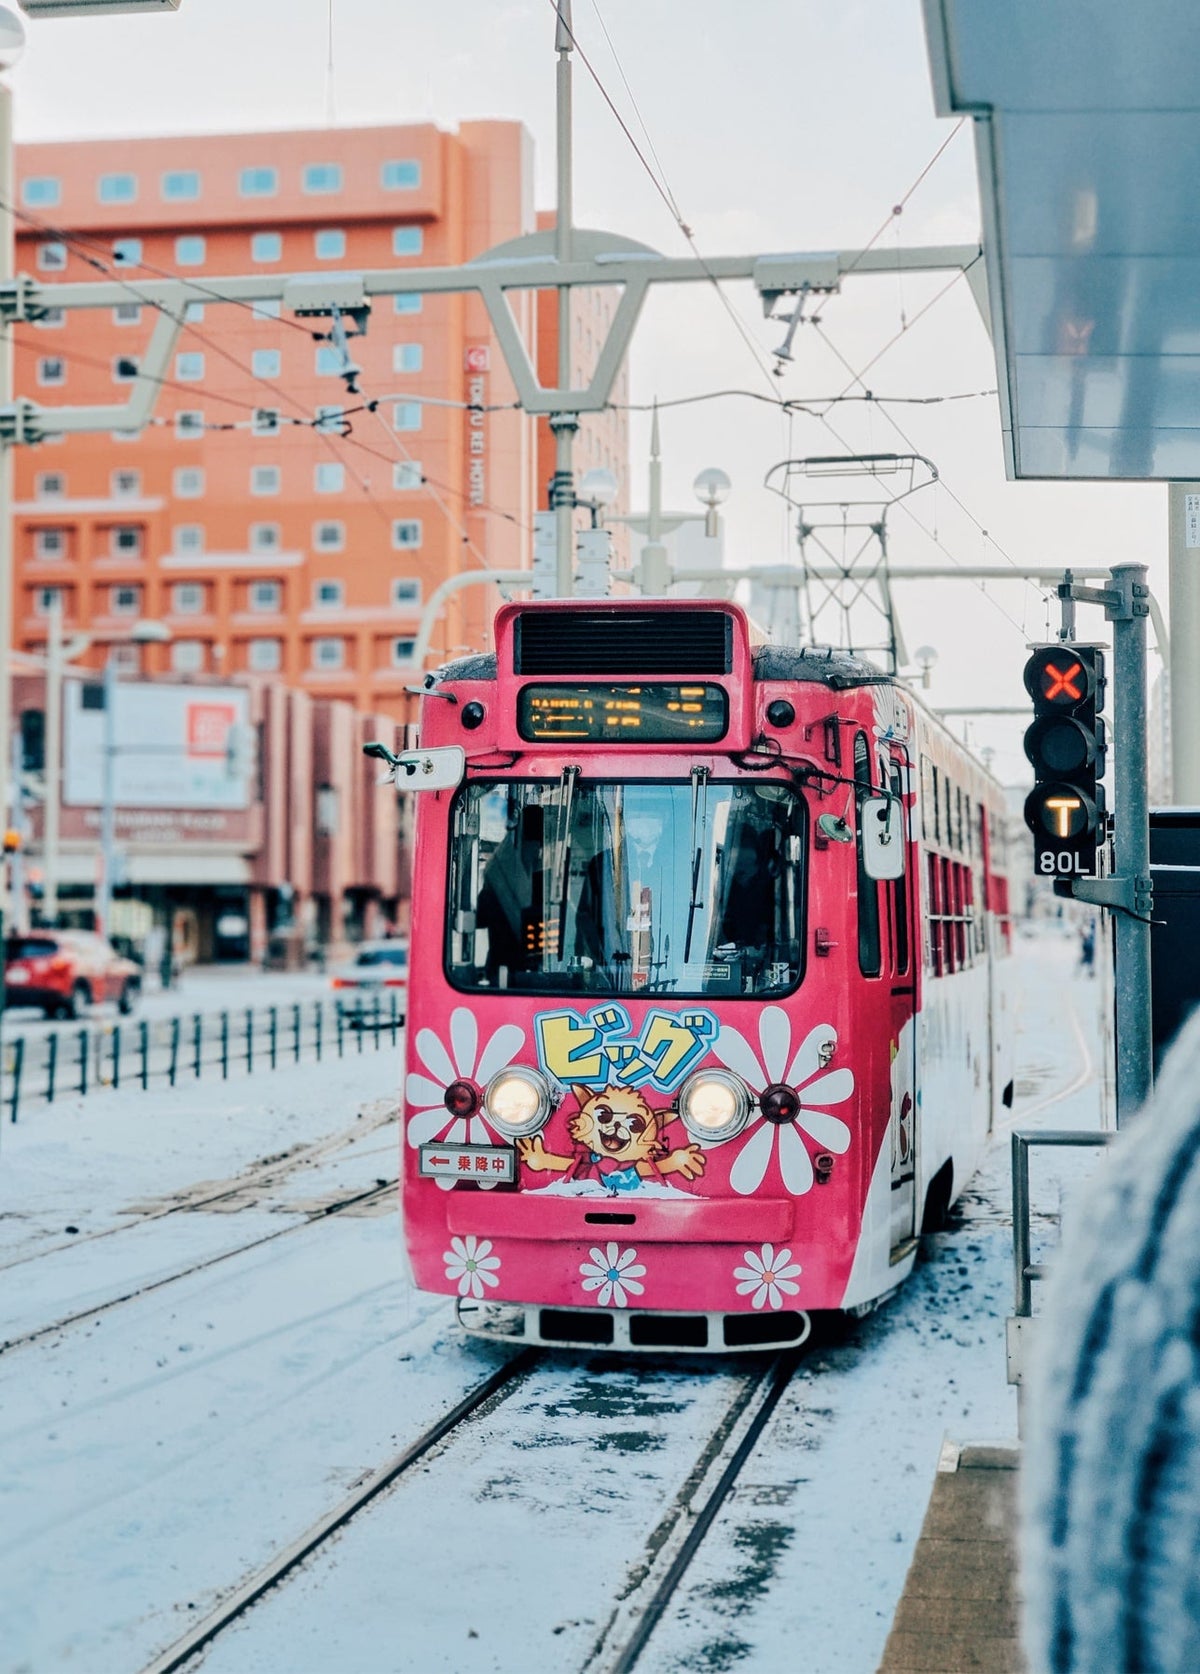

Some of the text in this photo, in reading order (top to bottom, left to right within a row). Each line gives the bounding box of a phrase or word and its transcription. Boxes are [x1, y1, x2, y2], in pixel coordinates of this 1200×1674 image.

[469, 459, 484, 506] HOTEL
[1040, 851, 1090, 874] 80L
[537, 1003, 716, 1089] ビッグ
[457, 1156, 505, 1173] 乗降中
